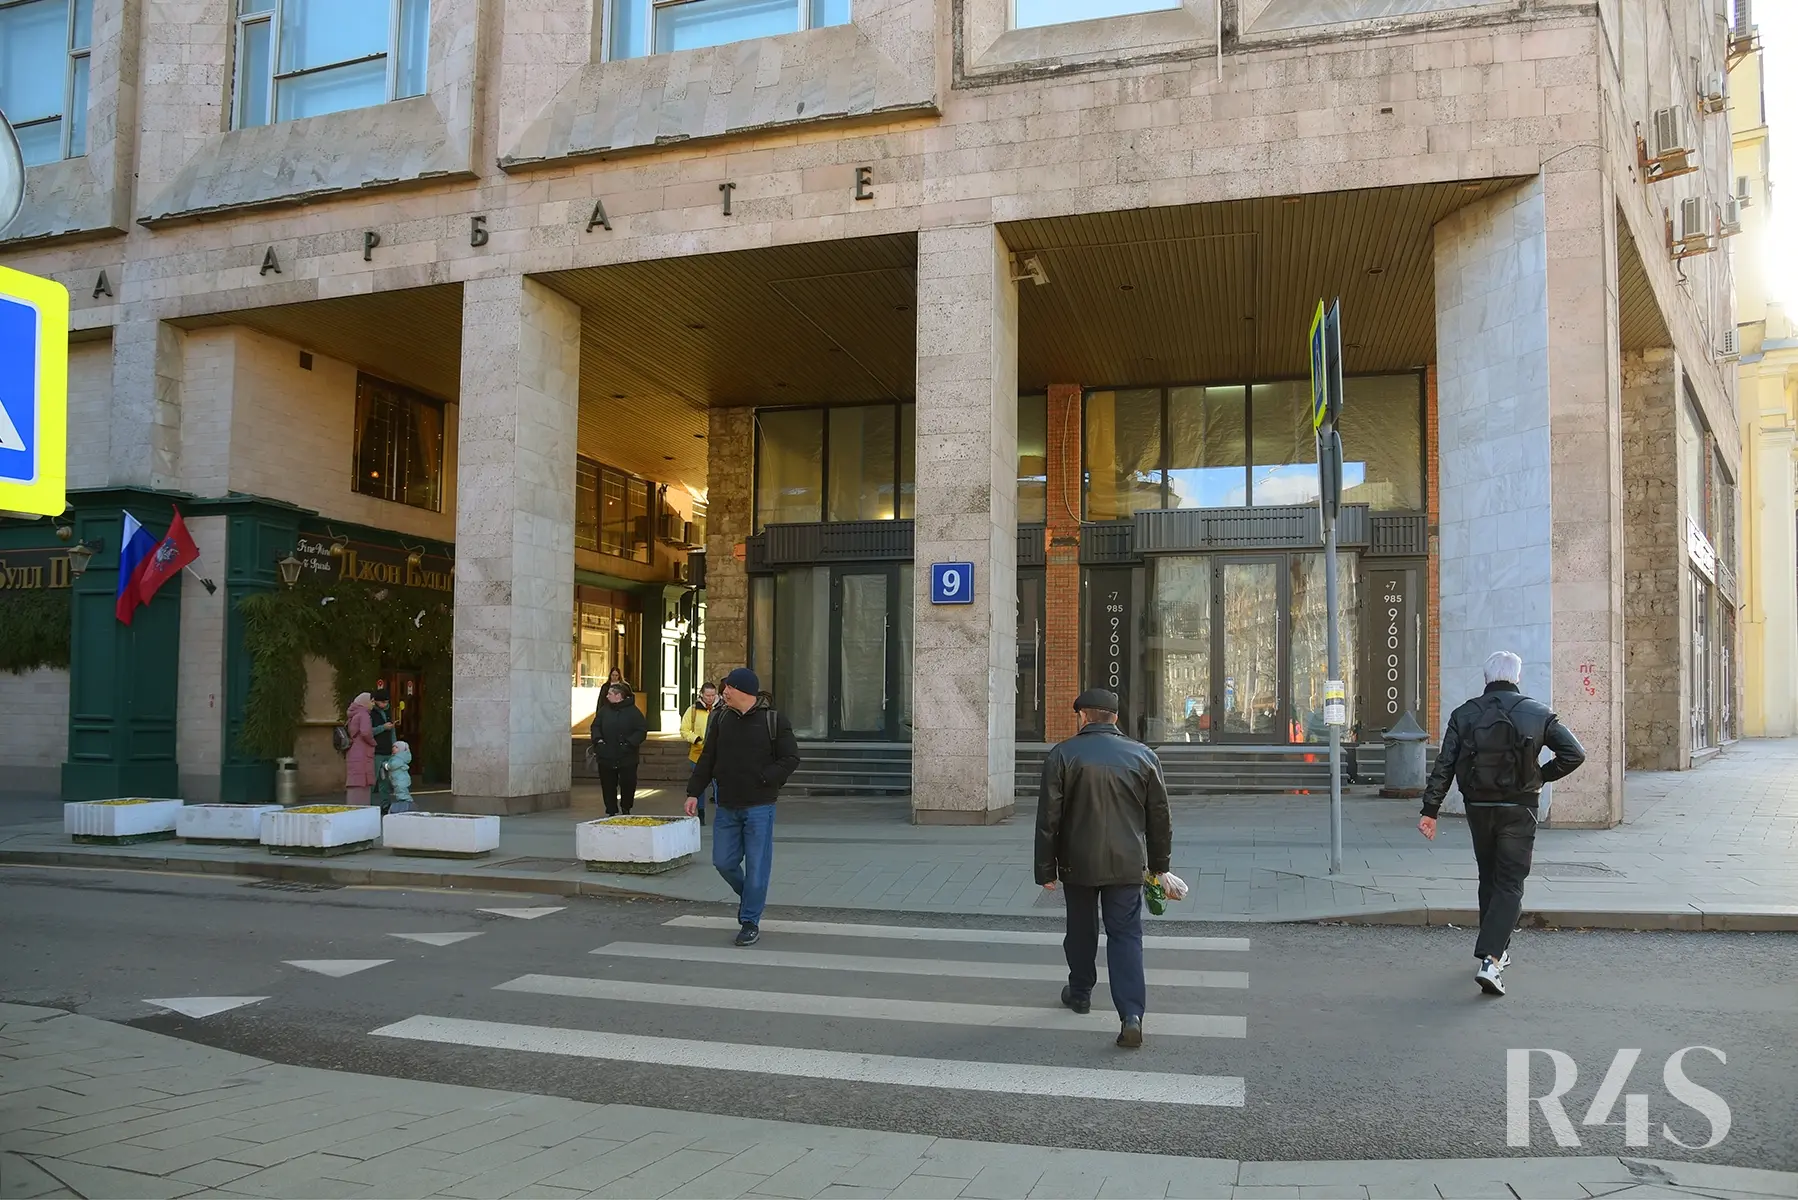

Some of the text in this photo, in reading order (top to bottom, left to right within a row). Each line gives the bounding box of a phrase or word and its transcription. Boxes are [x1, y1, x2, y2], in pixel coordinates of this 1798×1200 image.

[259, 166, 874, 276] АРБАТЕ
[942, 569, 961, 596] 9
[1385, 581, 1396, 591] +7
[1108, 591, 1118, 601] +7
[1383, 594, 1402, 603] 985
[1106, 604, 1124, 613] 985
[1109, 617, 1120, 657] 960
[1387, 608, 1398, 714] 960 00 00
